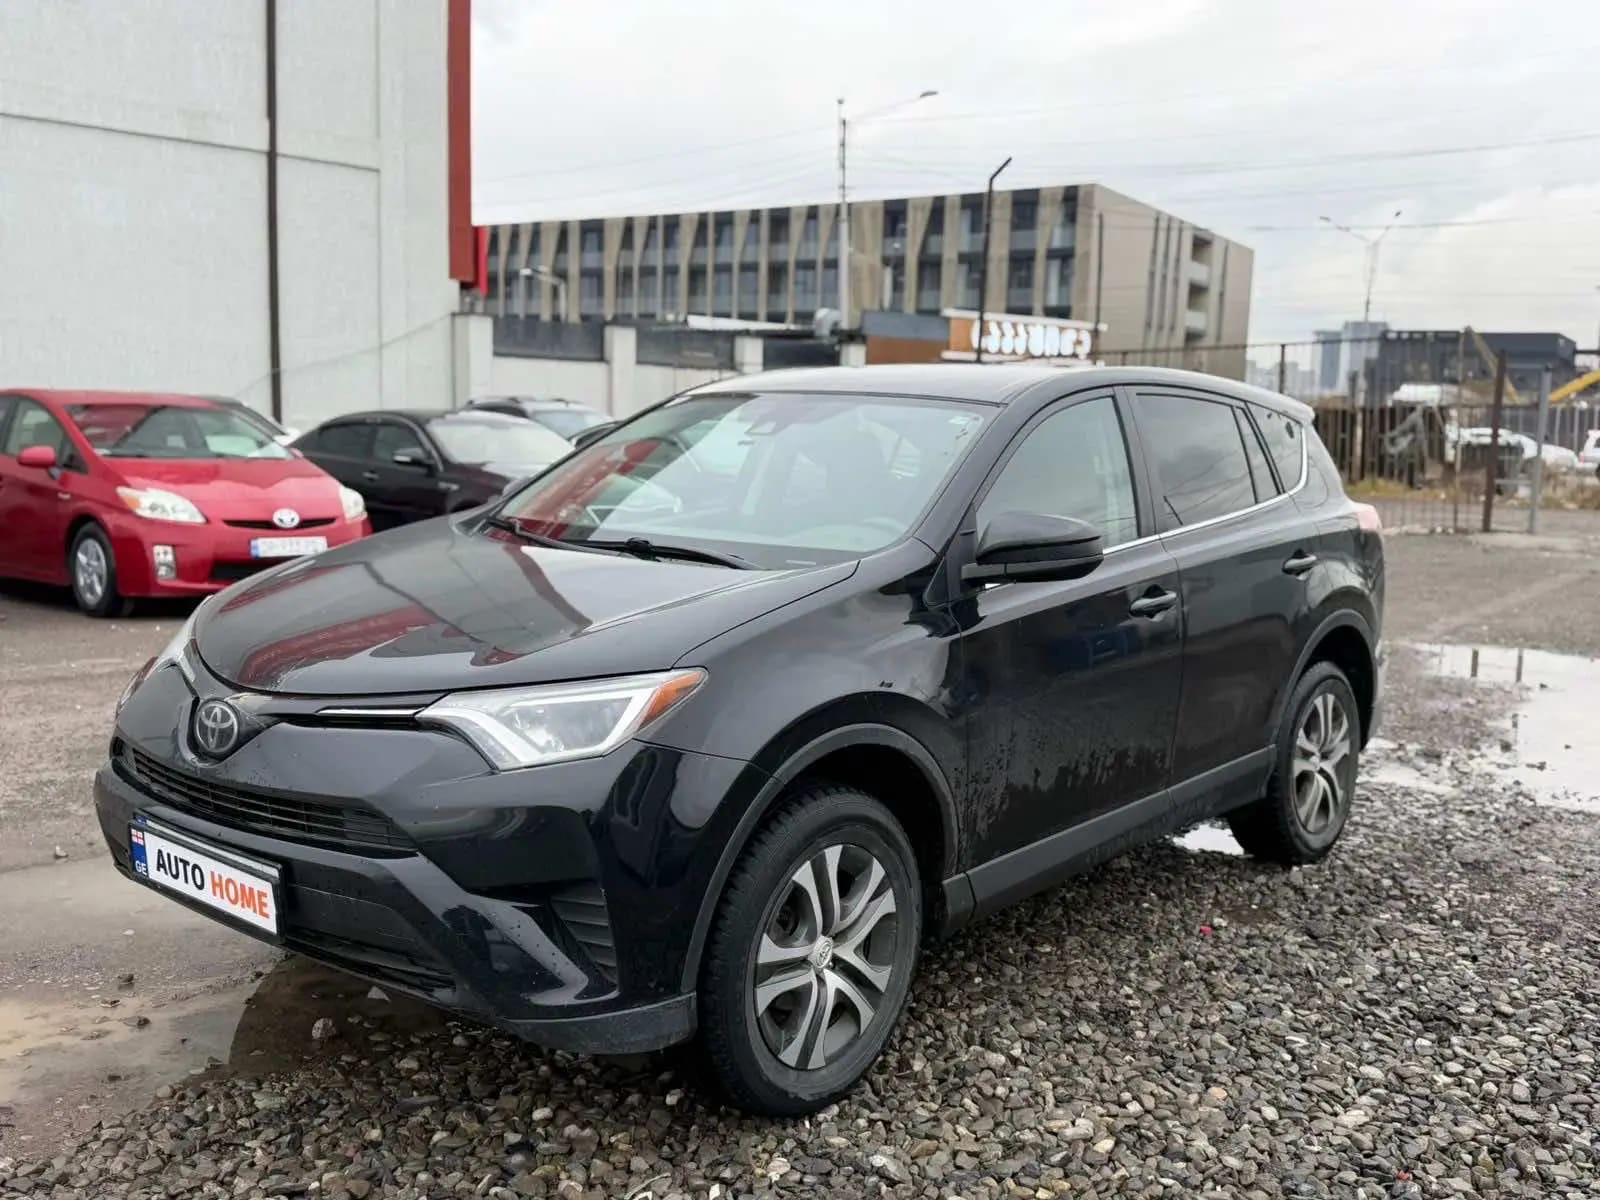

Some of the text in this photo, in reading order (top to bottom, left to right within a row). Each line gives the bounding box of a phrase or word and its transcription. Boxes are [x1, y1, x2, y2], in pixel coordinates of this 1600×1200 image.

[135, 860, 147, 875] GE
[156, 849, 270, 919] AUTO HOME
